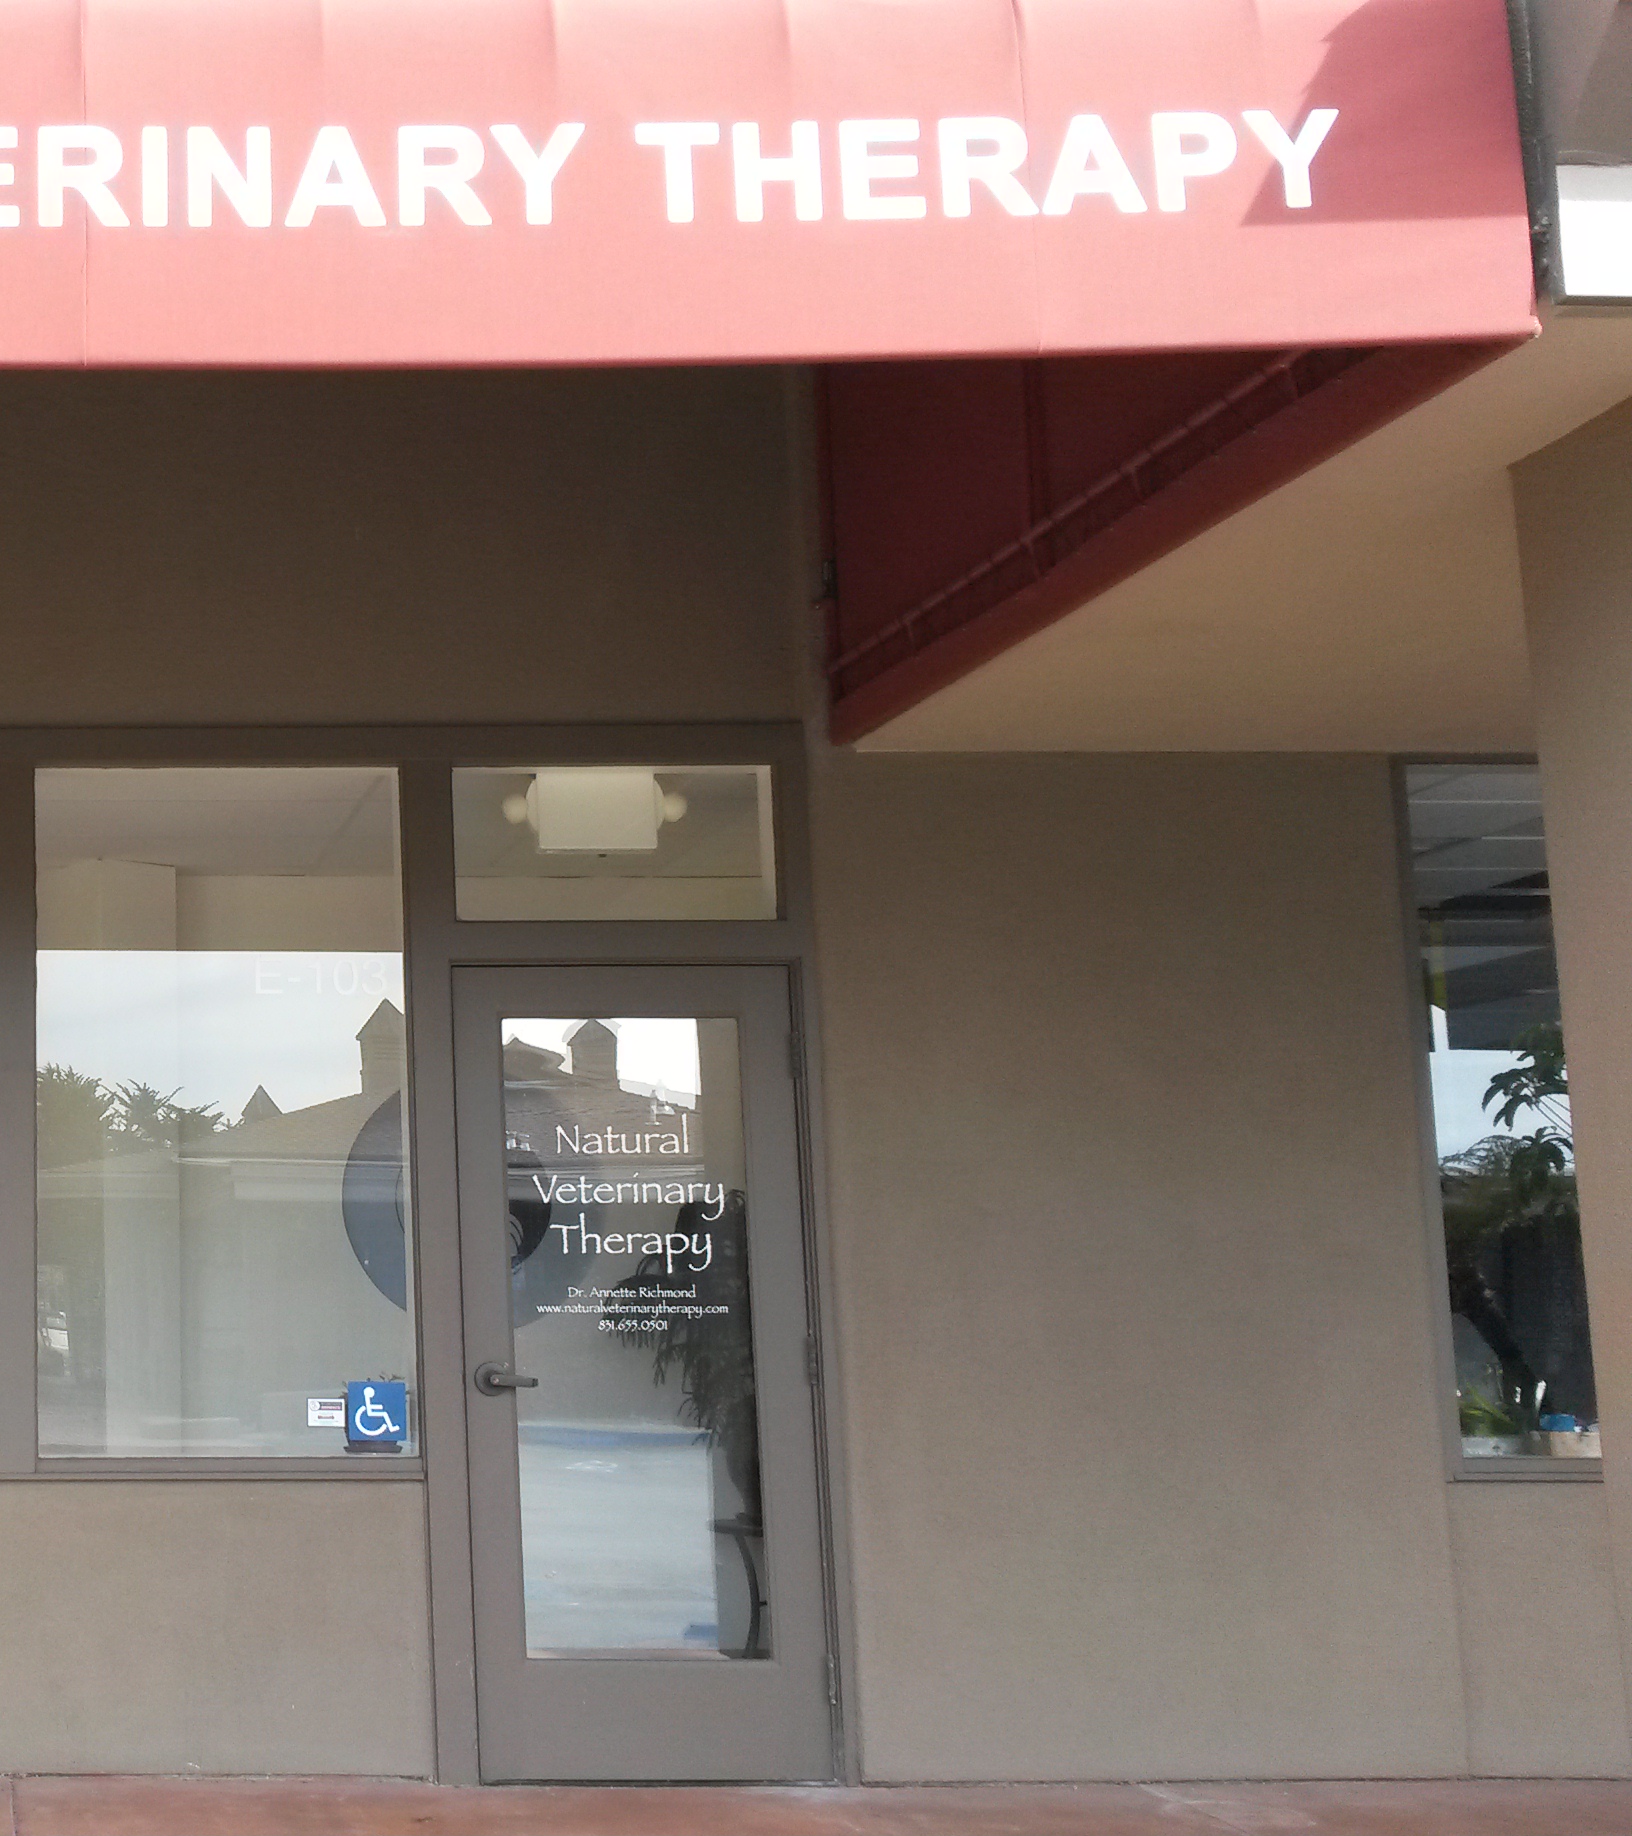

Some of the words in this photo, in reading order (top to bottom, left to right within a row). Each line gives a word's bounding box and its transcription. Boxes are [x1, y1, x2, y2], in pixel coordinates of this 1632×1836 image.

[632, 108, 1340, 224] THERAPY
[254, 957, 388, 996] E-103
[554, 1113, 690, 1155] Natural
[531, 1171, 725, 1222] Veterinary
[549, 1212, 713, 1275] Therapy
[536, 1300, 729, 1320] www.naturalveterinarytherapy.com
[567, 1286, 587, 1299] Dr.
[589, 1285, 637, 1299] Annette
[639, 1283, 697, 1299] Richmond
[597, 1318, 669, 1333] 831.655.0501
